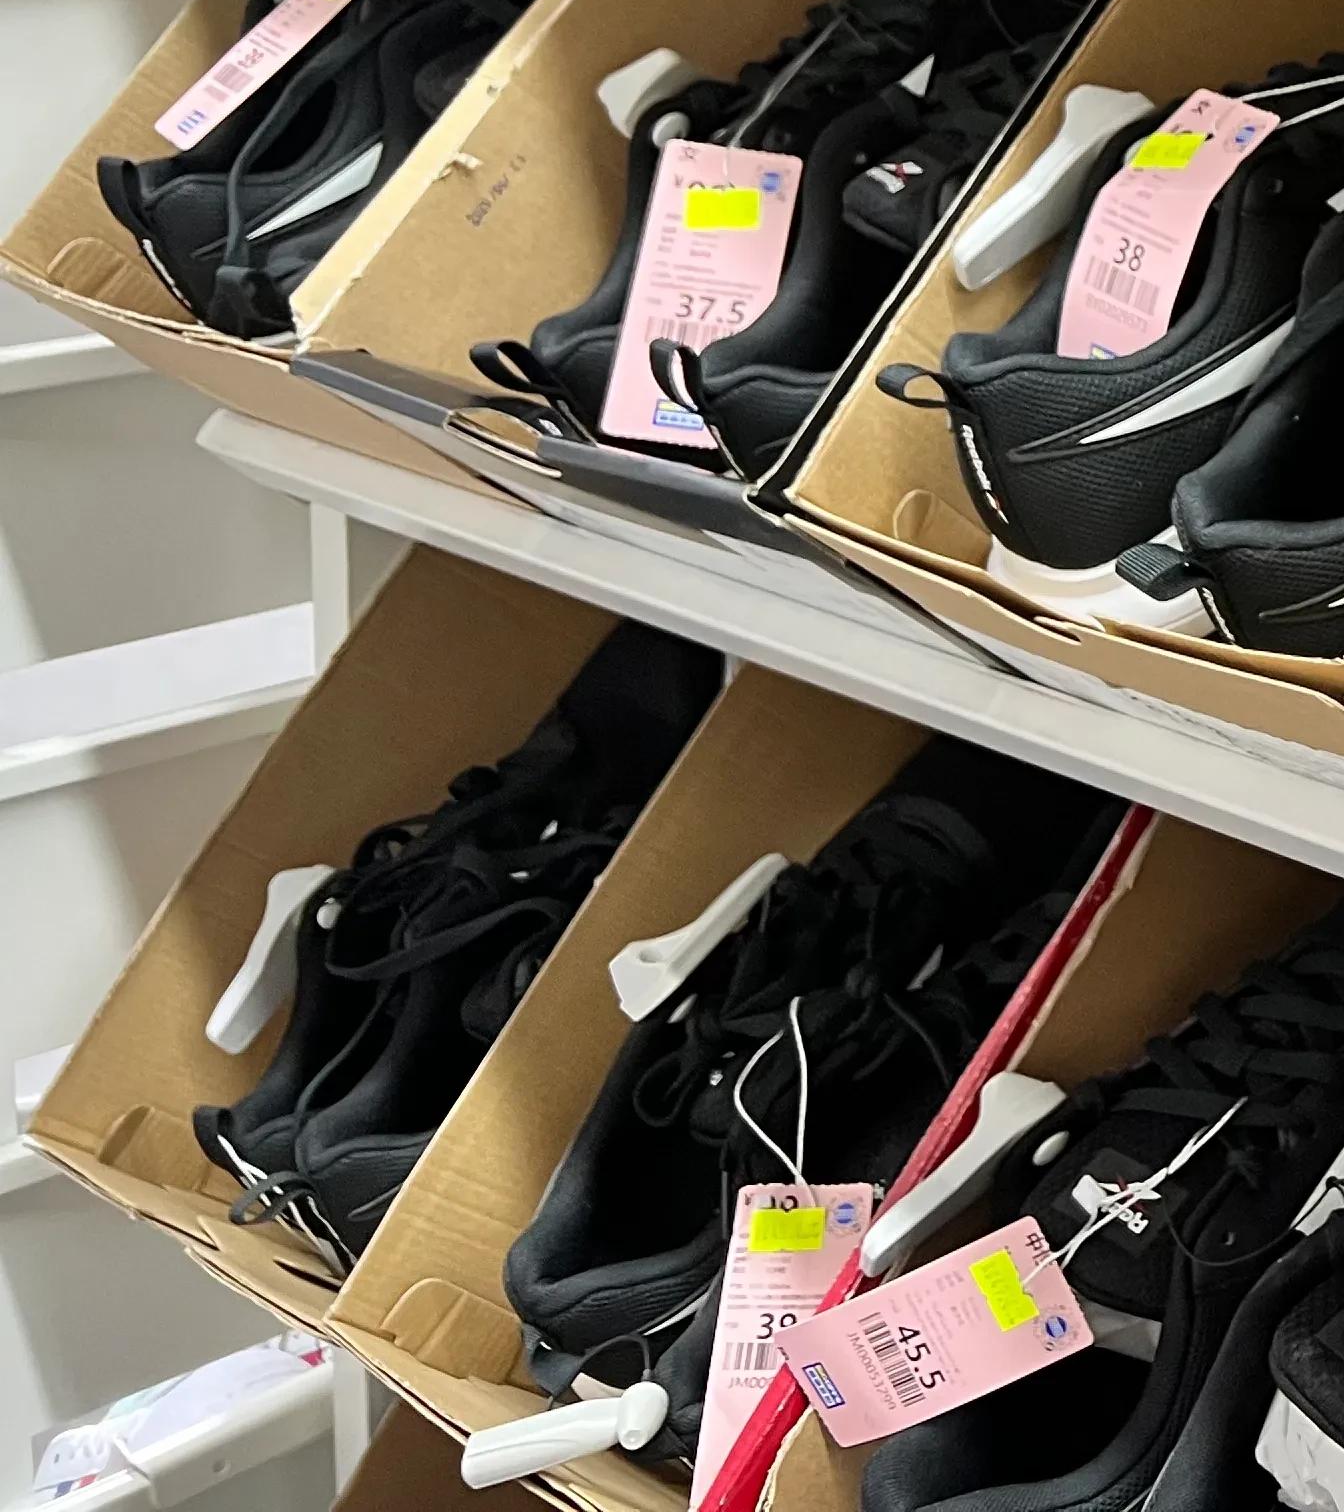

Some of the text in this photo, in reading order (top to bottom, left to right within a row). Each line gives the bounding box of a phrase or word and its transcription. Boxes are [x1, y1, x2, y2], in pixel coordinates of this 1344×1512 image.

[1112, 237, 1146, 272] 38
[675, 292, 747, 325] 37.5
[898, 1325, 946, 1390] 45.5
